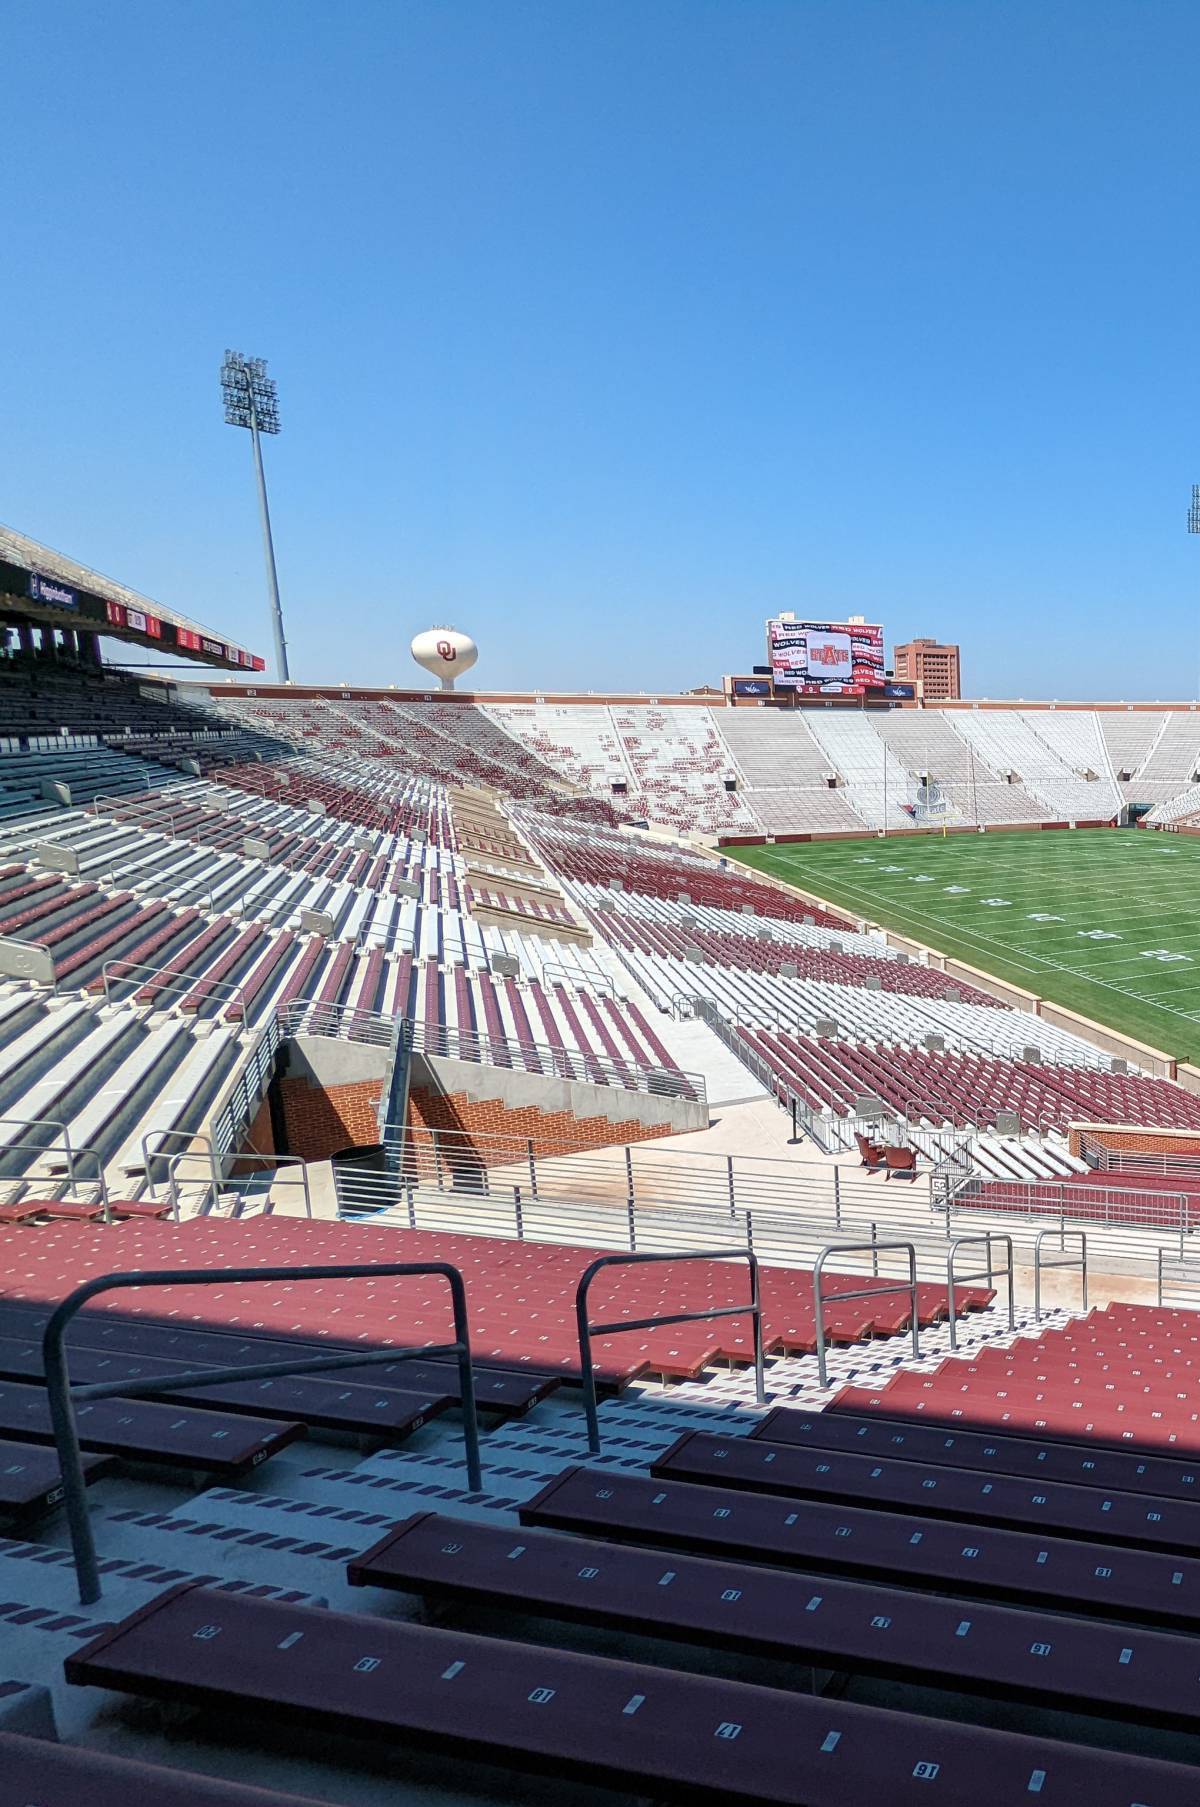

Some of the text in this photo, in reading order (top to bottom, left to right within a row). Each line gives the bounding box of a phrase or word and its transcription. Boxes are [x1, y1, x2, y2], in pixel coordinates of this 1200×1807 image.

[773, 640, 805, 648] WOLVES
[437, 641, 456, 661] OU
[1139, 949, 1187, 962] 20
[872, 1617, 890, 1627] 17
[1031, 1644, 1050, 1654] 16
[356, 1658, 379, 1671] 19
[529, 1689, 555, 1702] 18
[715, 1723, 741, 1738] 17
[914, 1763, 938, 1778] 16
